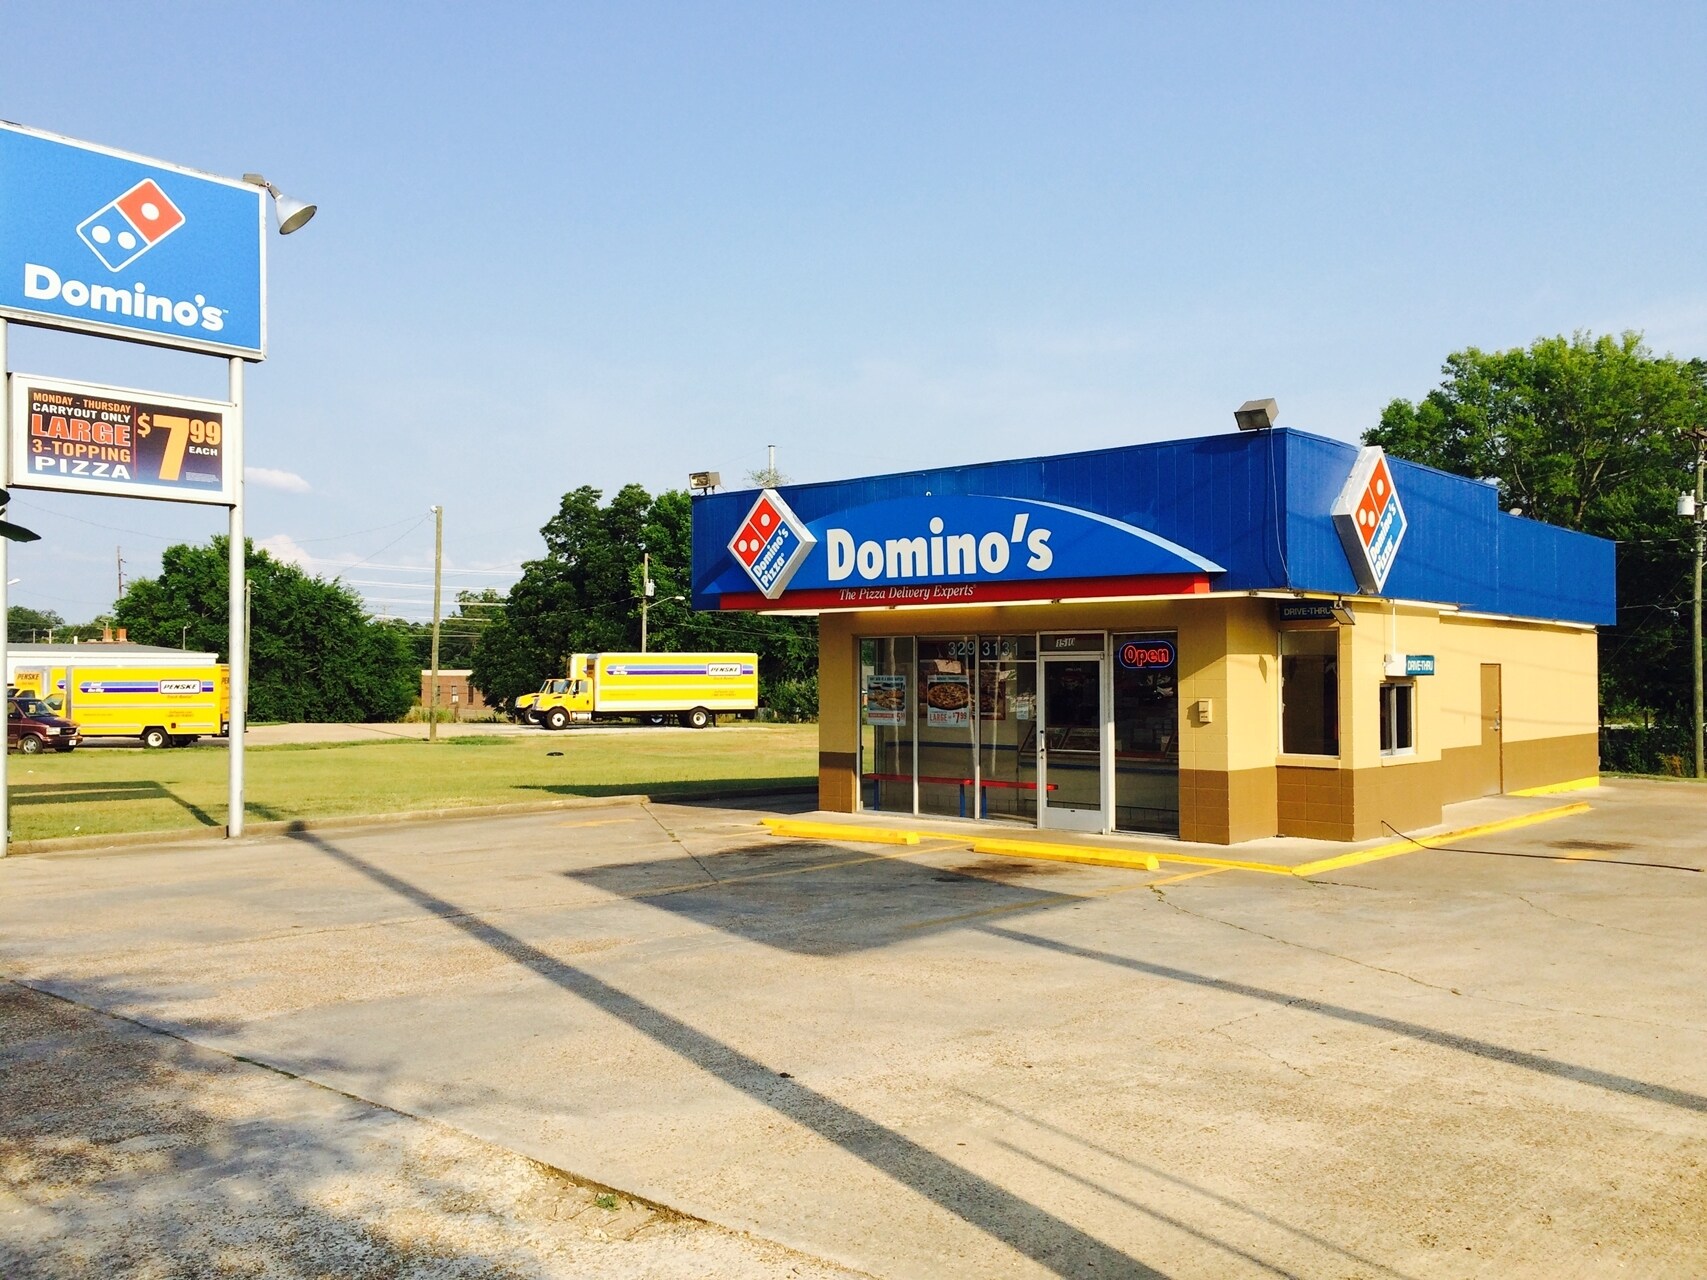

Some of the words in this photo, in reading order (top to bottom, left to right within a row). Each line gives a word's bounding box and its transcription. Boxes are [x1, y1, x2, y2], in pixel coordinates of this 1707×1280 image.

[23, 262, 225, 332] Domino's
[32, 402, 97, 419] CARRYOUT
[101, 412, 131, 423] ONLY
[33, 392, 73, 406] MONDAY
[83, 399, 131, 413] THURSDAY
[31, 413, 131, 447] LARGE
[32, 438, 131, 463] 3-TOPPING
[188, 445, 218, 457] EACH
[35, 455, 131, 480] PIZZA
[1369, 502, 1397, 563] Domino's
[751, 527, 789, 579] Domino's
[826, 513, 1053, 581] Domino's
[839, 588, 857, 601] The
[858, 587, 886, 600] Pizza
[888, 586, 931, 601] Delivery
[933, 584, 974, 599] Experts
[947, 641, 976, 656] 329
[982, 640, 1019, 656] 3131
[1124, 645, 1169, 667] Open
[1407, 659, 1434, 671] DRIVE-THRU
[929, 713, 948, 722] LARGE
